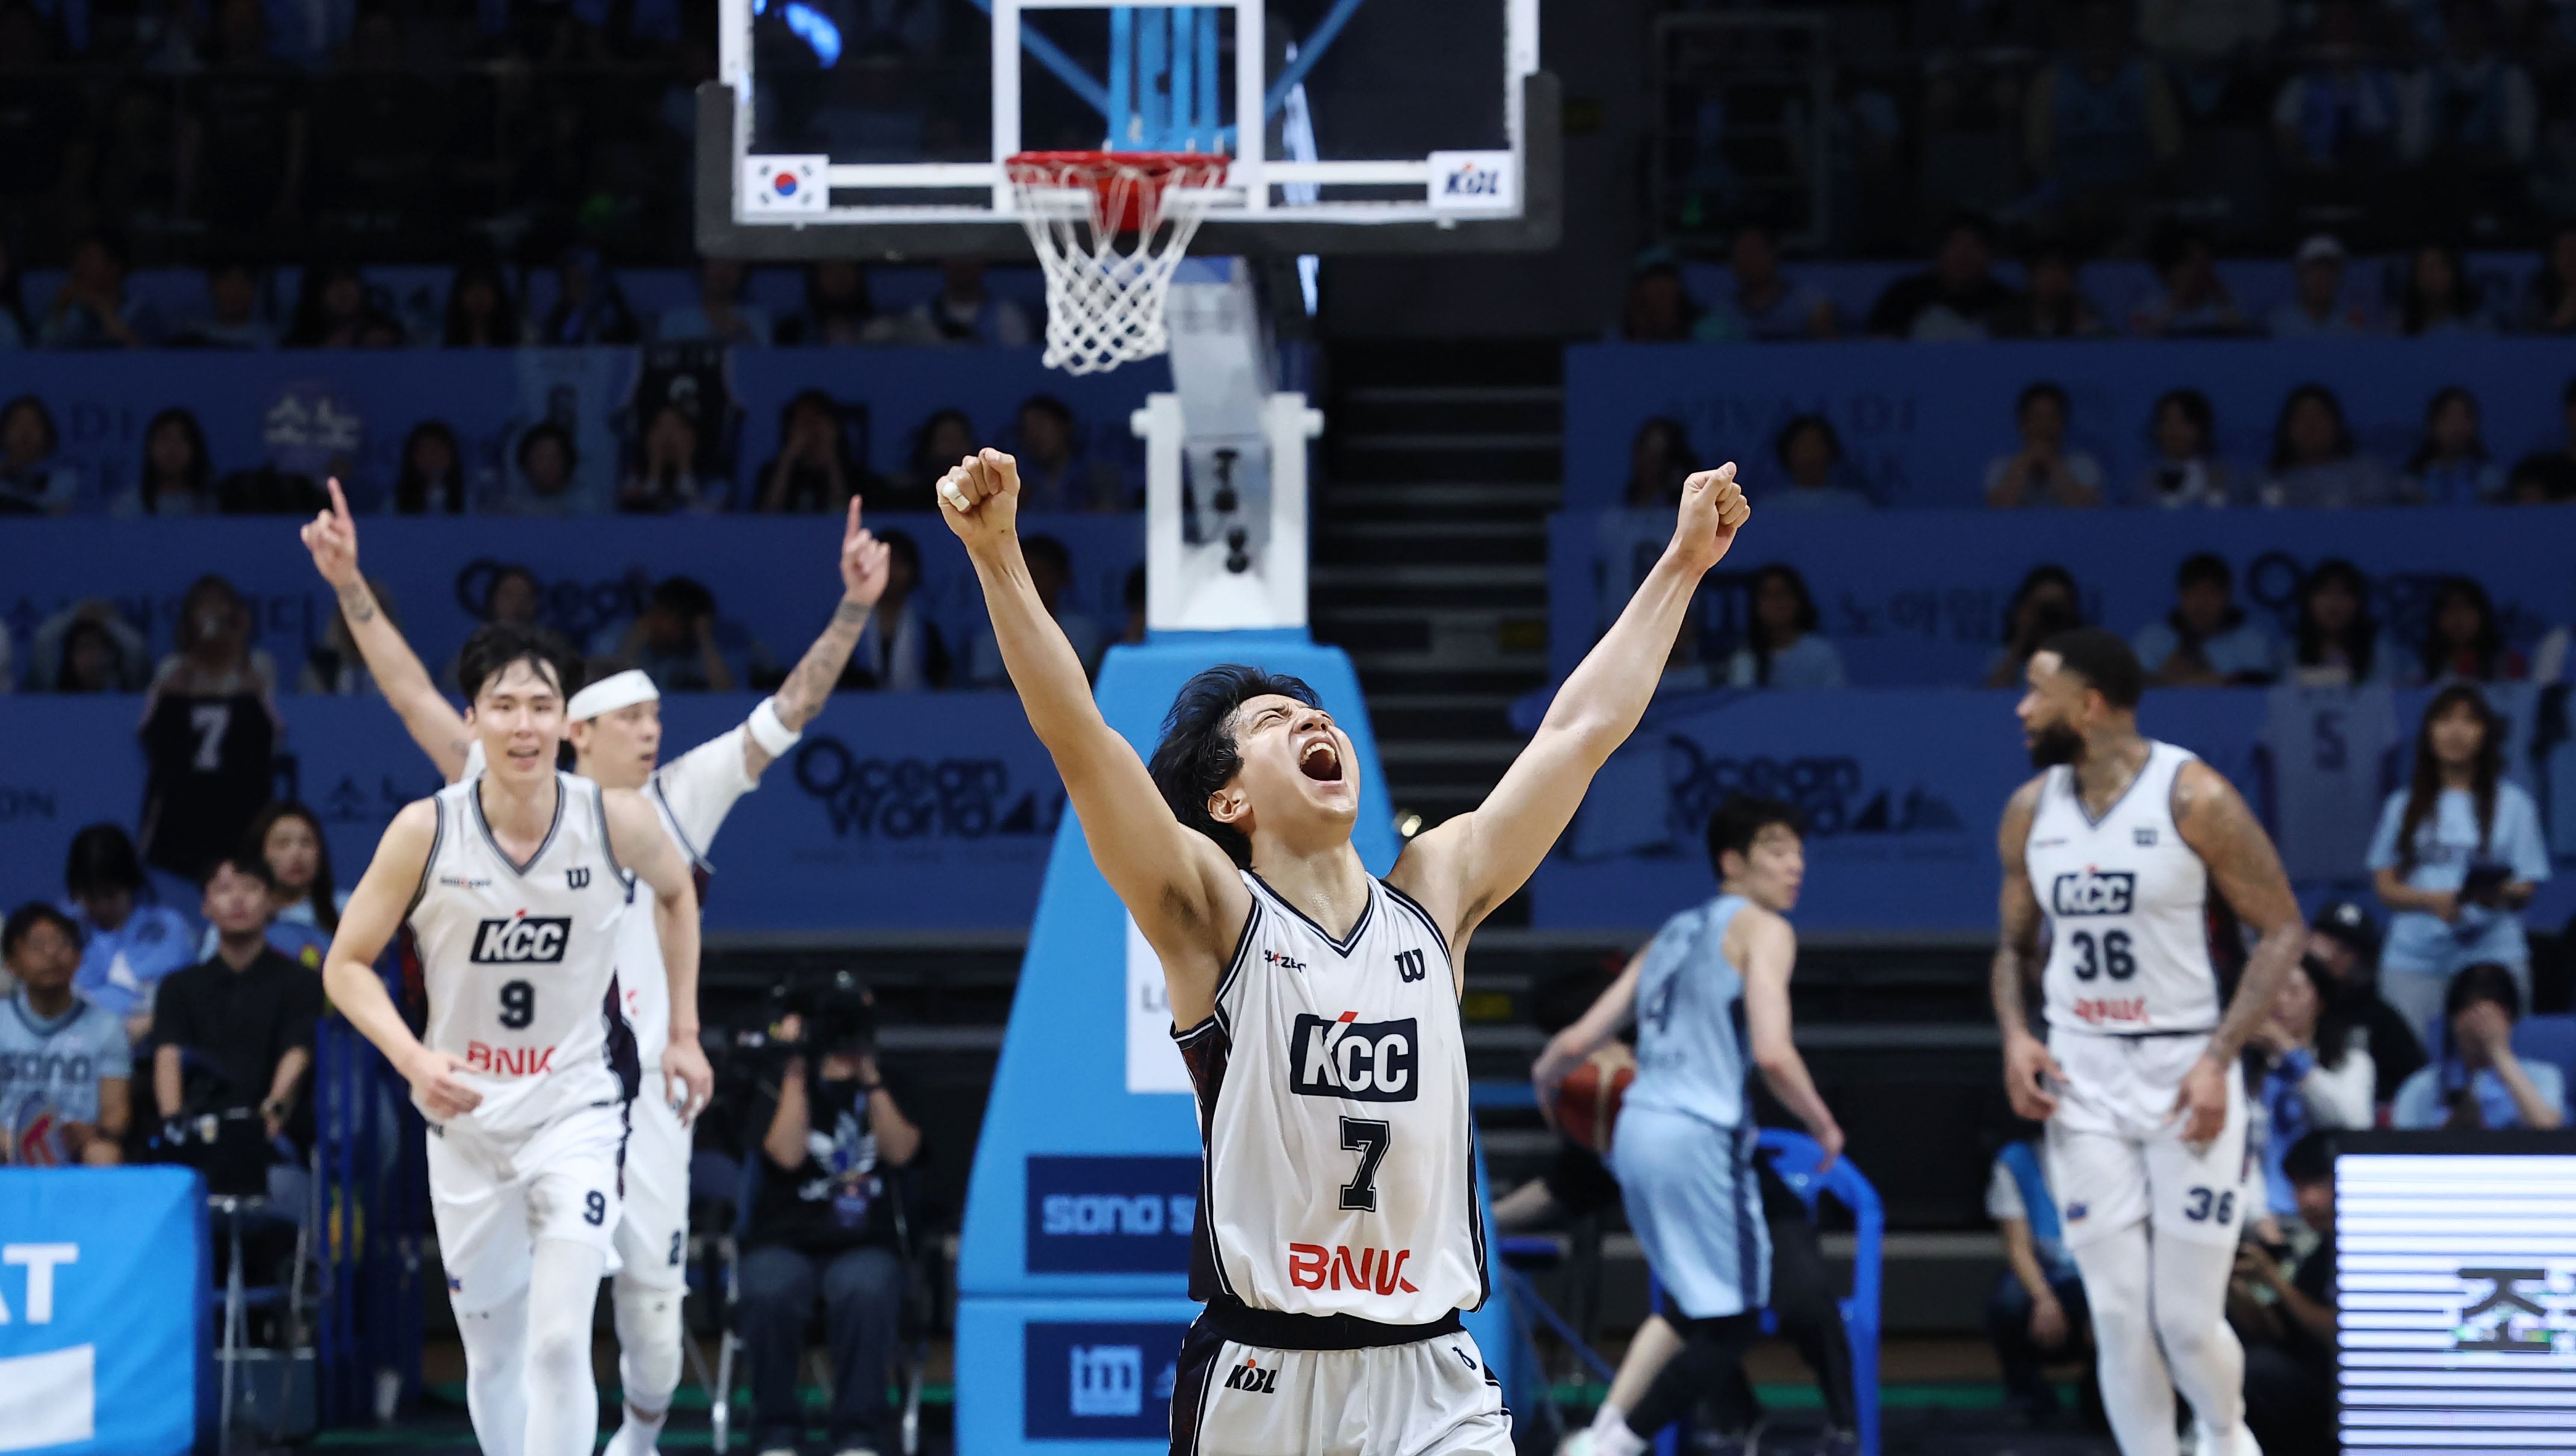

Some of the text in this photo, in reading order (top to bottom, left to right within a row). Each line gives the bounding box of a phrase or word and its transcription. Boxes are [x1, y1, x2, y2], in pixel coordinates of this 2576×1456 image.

[191, 705, 229, 770] 7
[2313, 708, 2348, 774] 5
[794, 736, 1008, 798] Ocean
[824, 784, 994, 841] World
[479, 909, 564, 962] KCC
[2072, 930, 2136, 982] 36
[1394, 948, 1426, 983] W
[499, 980, 535, 1030] 9
[467, 1039, 556, 1076] BNK
[1302, 1012, 1410, 1093] KCC
[1339, 1115, 1390, 1213] 7
[584, 1190, 606, 1226] 9
[2185, 1186, 2235, 1225] 36
[1289, 1242, 1420, 1296] BNK
[1224, 1359, 1278, 1394] KBL
